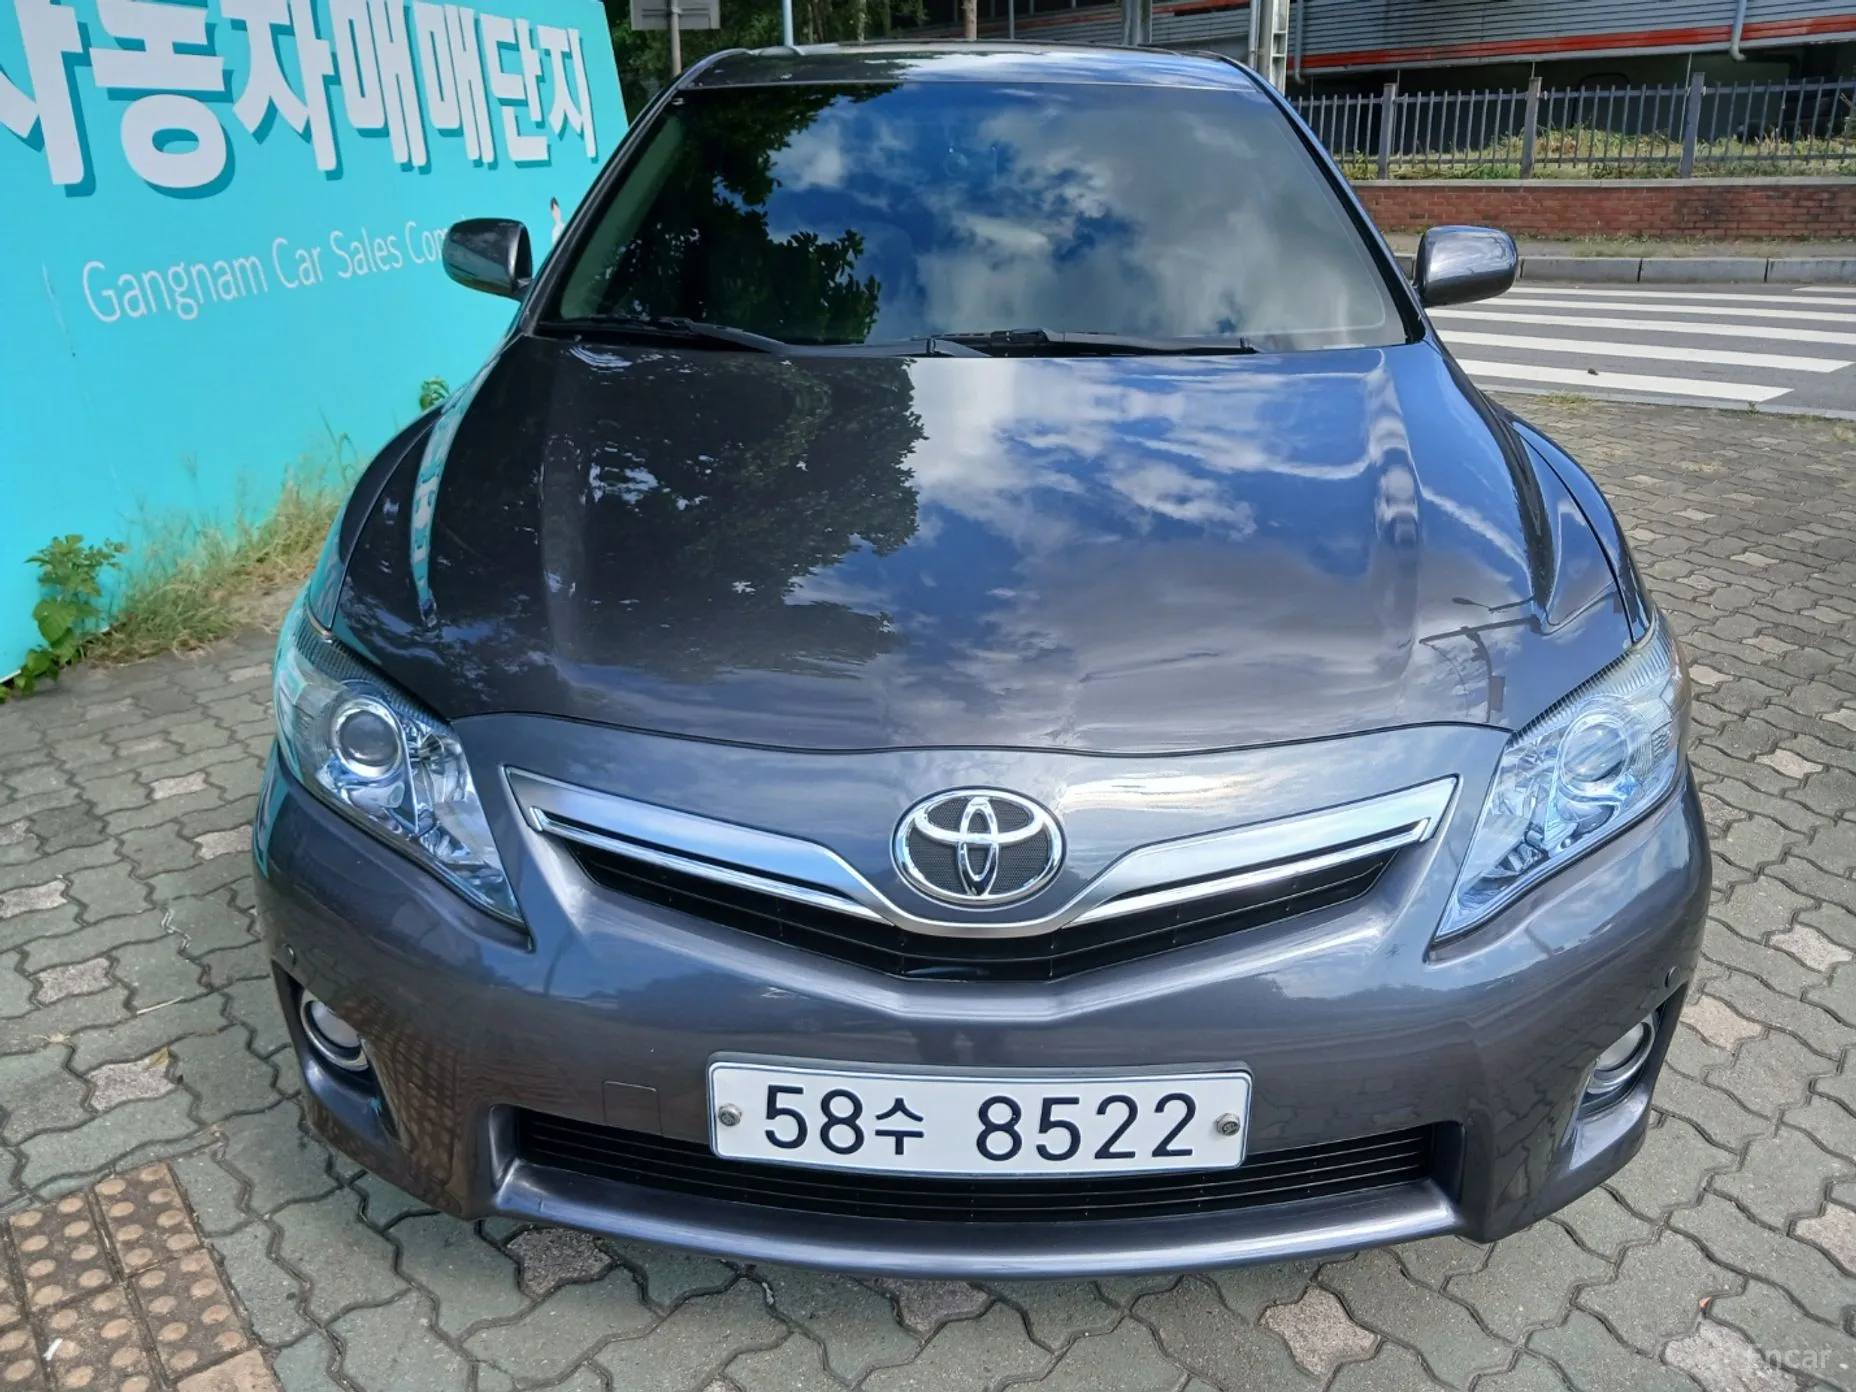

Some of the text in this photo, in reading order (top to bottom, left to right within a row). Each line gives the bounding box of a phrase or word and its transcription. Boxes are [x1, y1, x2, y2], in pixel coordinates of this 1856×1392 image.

[82, 219, 449, 322] Gangnam Car Sales Com
[764, 1084, 1197, 1161] 58수 8522
